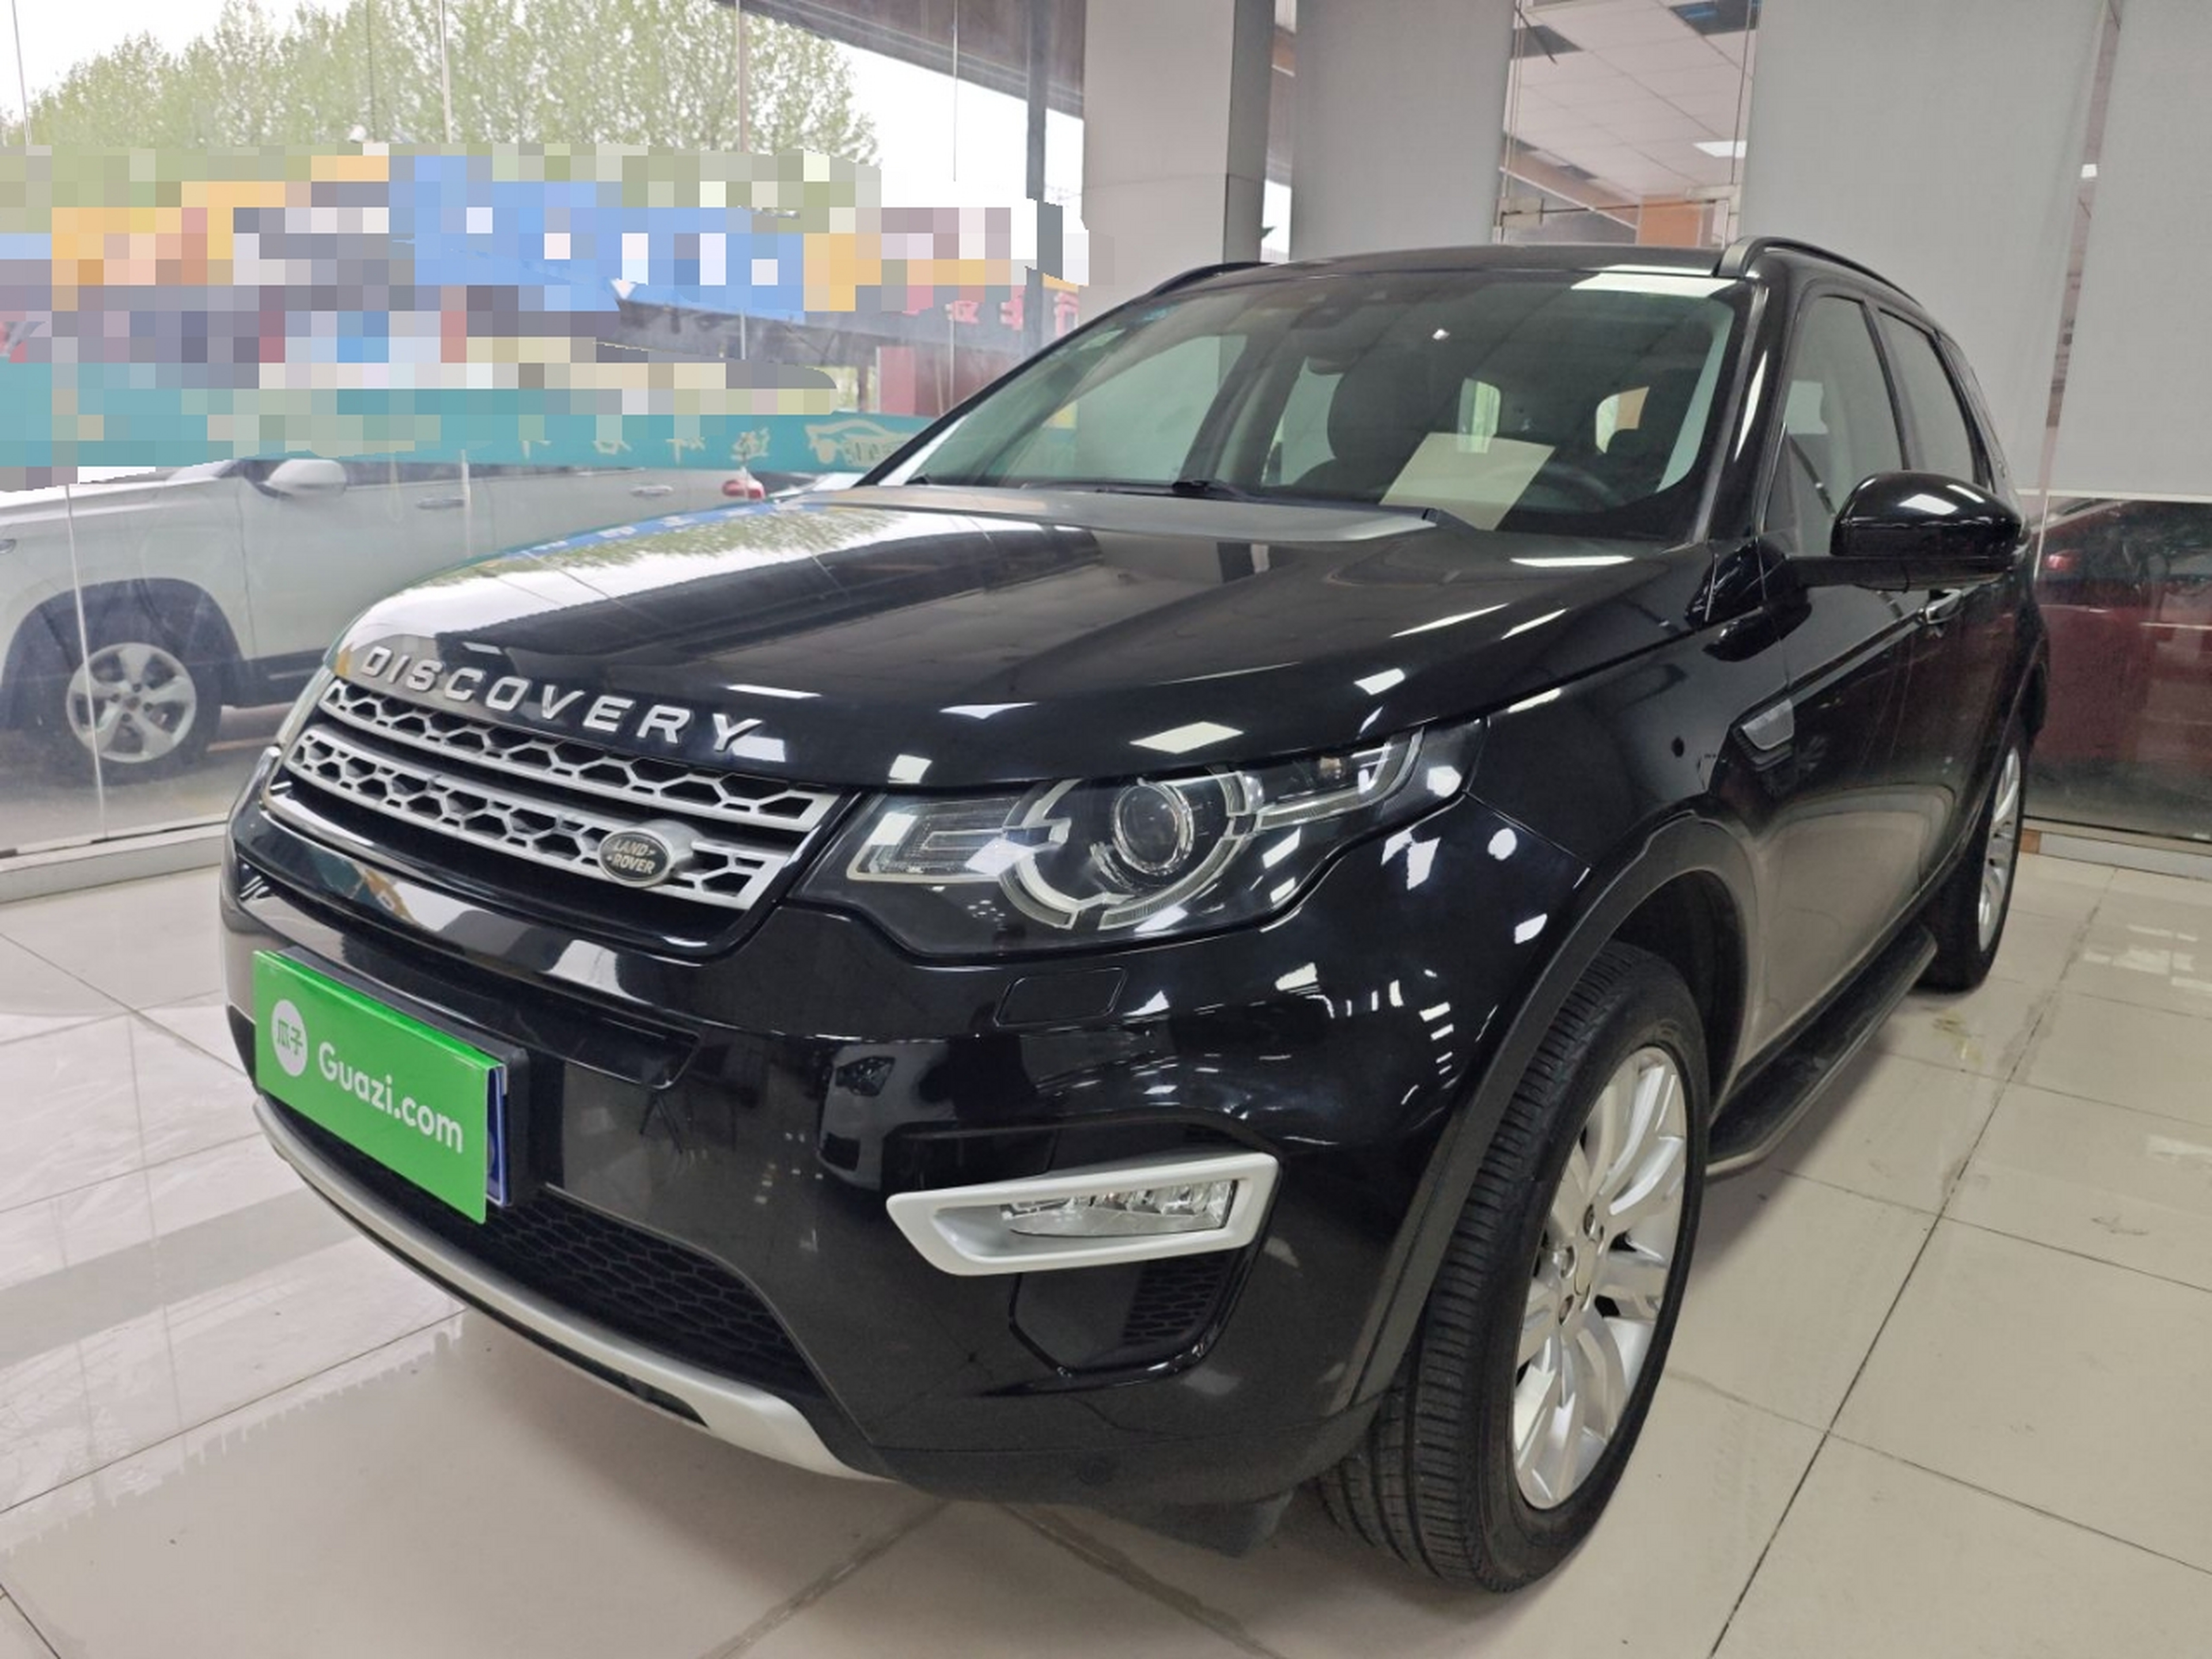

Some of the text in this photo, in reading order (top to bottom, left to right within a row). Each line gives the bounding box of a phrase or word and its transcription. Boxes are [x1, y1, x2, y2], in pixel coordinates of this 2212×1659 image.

[361, 646, 762, 753] DISCOVERY
[612, 854, 656, 874] ROVER
[614, 840, 649, 856] LAND
[278, 1019, 303, 1055] 瓜子
[319, 1042, 463, 1154] Guazi.com
